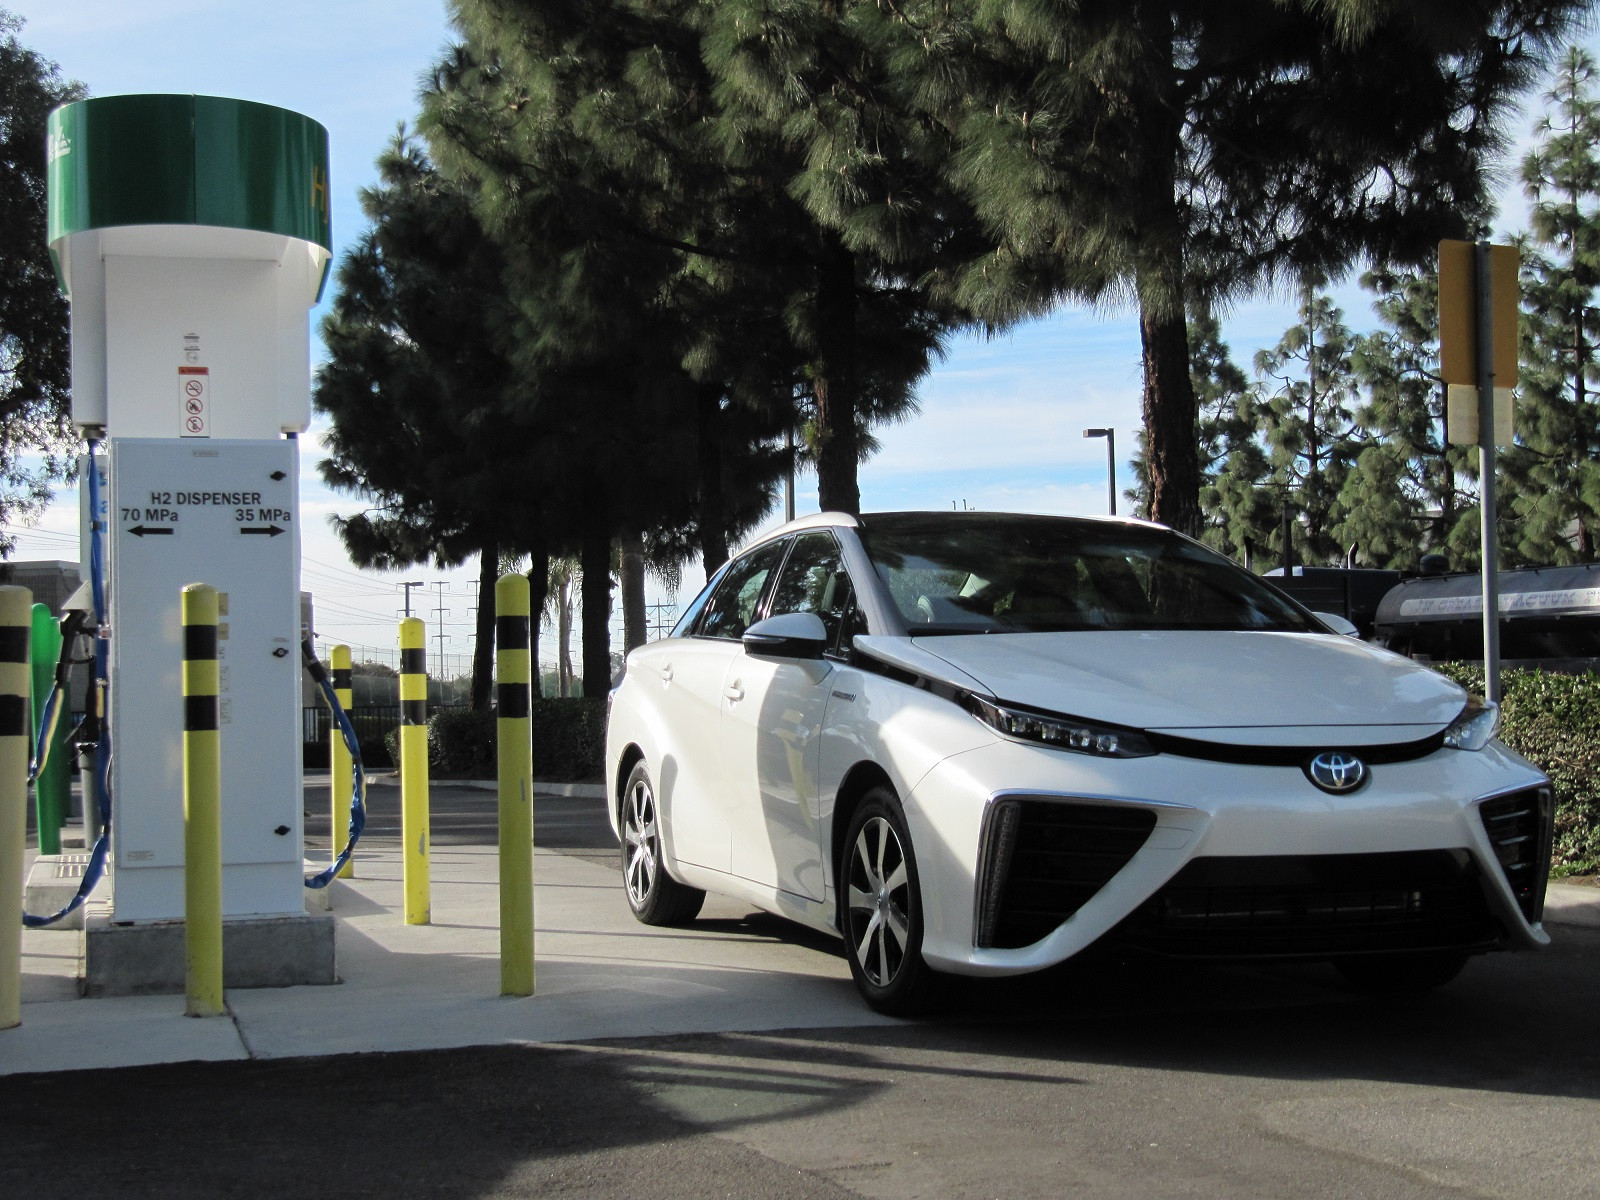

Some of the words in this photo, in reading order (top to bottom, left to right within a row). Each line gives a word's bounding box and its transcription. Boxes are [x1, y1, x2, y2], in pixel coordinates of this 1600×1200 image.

[151, 492, 171, 505] H2
[177, 492, 262, 505] DISPENSER
[121, 508, 141, 522] 70
[146, 508, 179, 522] MPa
[235, 508, 255, 522] 35
[259, 508, 291, 522] MPa
[1503, 592, 1576, 608] VACUUM
